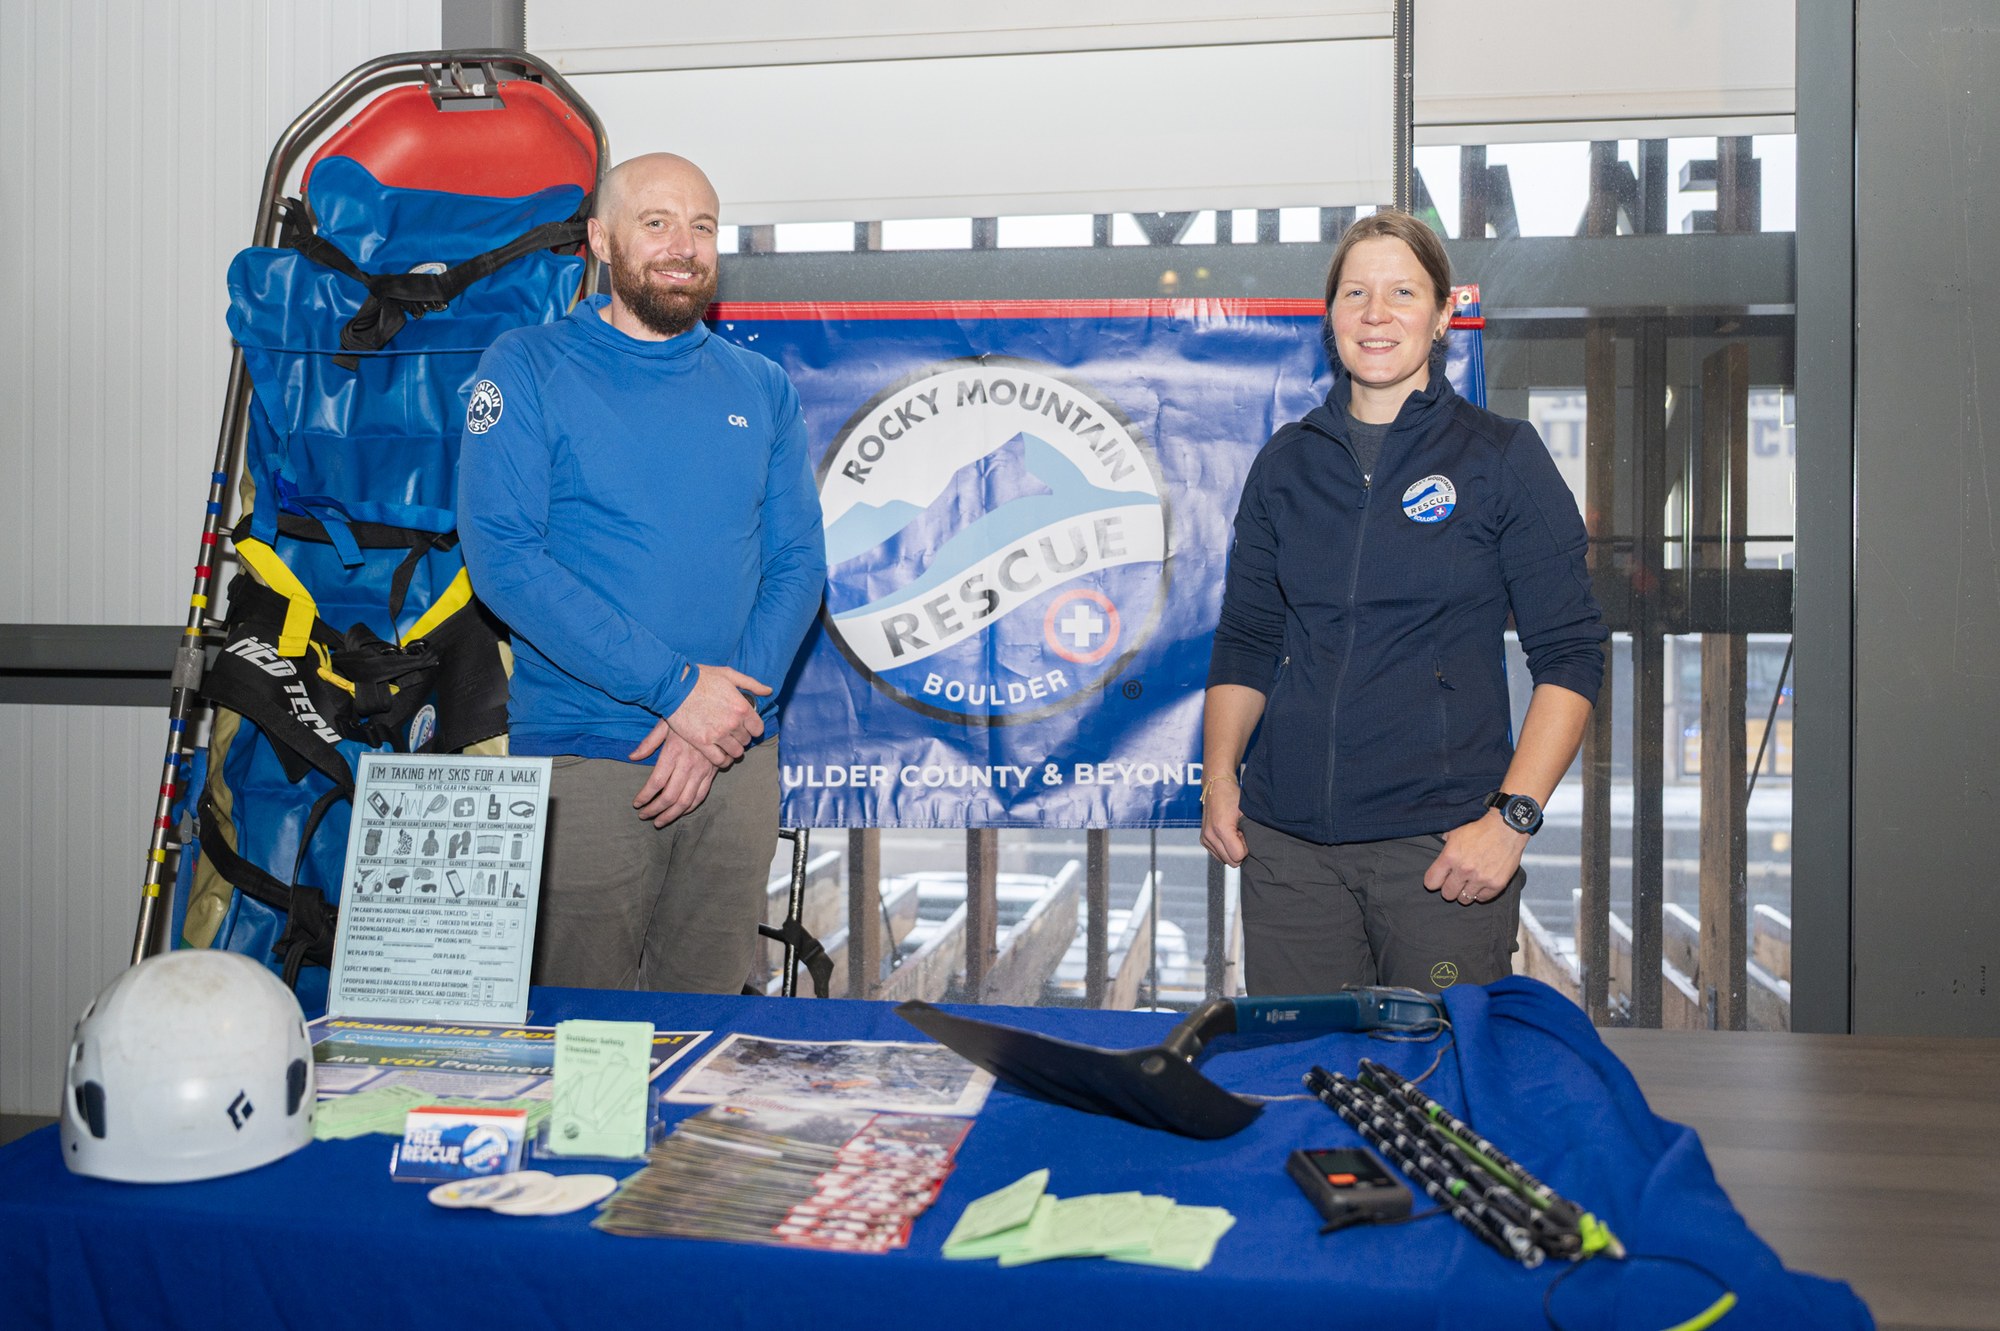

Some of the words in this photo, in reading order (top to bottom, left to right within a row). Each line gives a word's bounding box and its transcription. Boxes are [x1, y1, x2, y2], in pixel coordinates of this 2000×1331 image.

[728, 414, 748, 427] OR
[841, 387, 939, 485] ROCKY
[956, 378, 1135, 483] MOUNTAIN
[1410, 495, 1450, 514] RESCUE
[880, 515, 1127, 658] RESCUE
[923, 668, 1069, 706] BOULDER
[371, 766, 386, 778] I'M
[391, 767, 424, 780] TAKING
[428, 768, 443, 781] MY
[448, 769, 470, 781] SKIS
[475, 769, 493, 781] FOR
[498, 770, 505, 782] A
[511, 771, 537, 783] WALK
[783, 765, 889, 787] ULDER
[900, 764, 1033, 788] COUNTY
[1042, 763, 1063, 785] &
[1074, 762, 1203, 786] BEYOND
[325, 1020, 492, 1036] Mountains
[500, 1029, 556, 1039] Don
[345, 1032, 415, 1043] Colorado
[418, 1037, 481, 1047] Weather
[326, 1055, 369, 1063] Are
[405, 1128, 443, 1146] FREE
[400, 1144, 462, 1164] RESCUE
